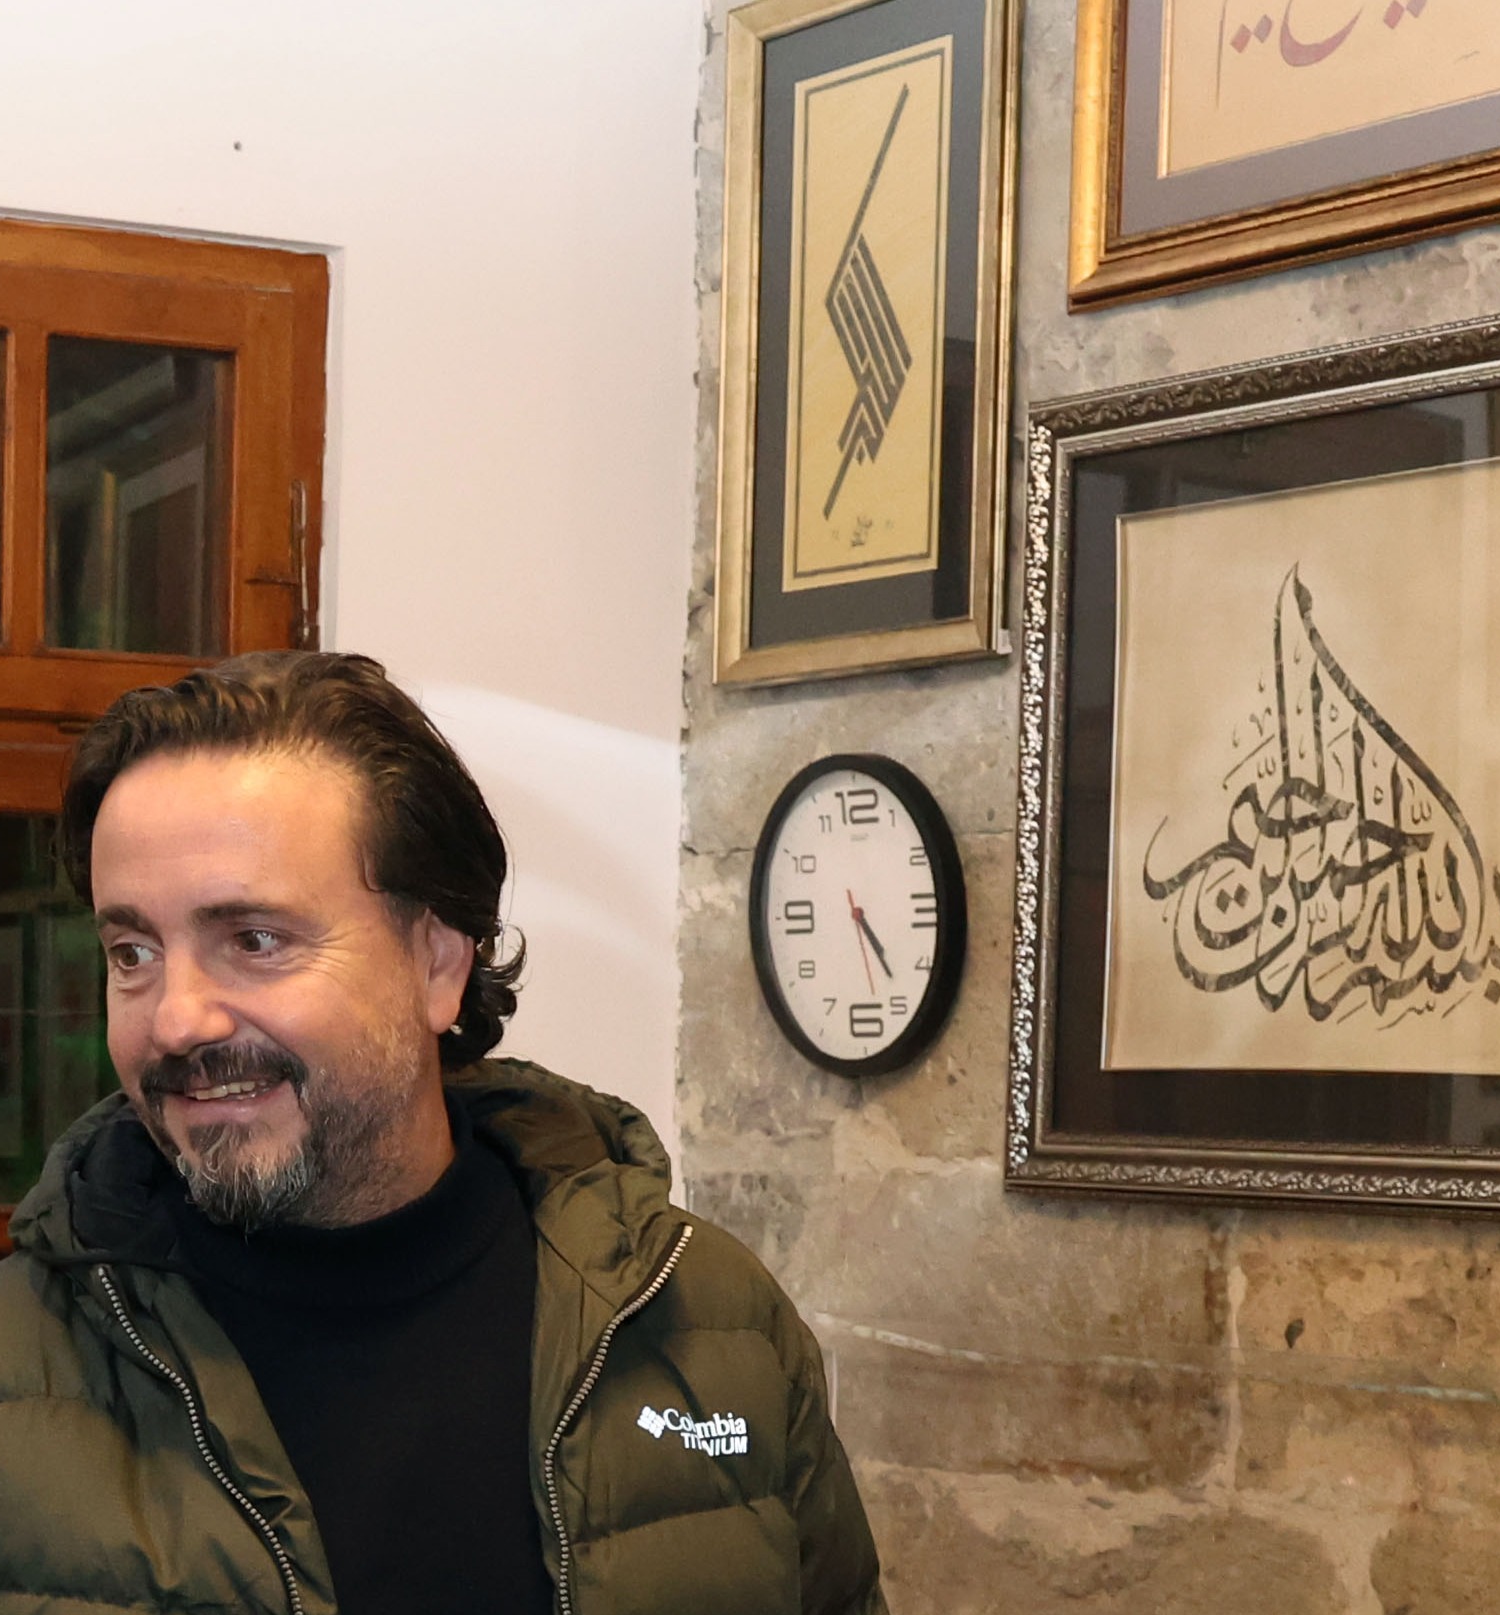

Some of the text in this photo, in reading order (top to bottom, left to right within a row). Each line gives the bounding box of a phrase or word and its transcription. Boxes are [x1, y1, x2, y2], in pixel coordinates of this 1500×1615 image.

[835, 789, 880, 825] 12
[819, 815, 832, 833] 11
[889, 809, 896, 828] 1
[792, 855, 816, 874] 10
[910, 847, 928, 866] 2
[784, 900, 815, 934] 9
[799, 960, 816, 979] 8
[915, 955, 931, 972] 4
[823, 997, 837, 1015] 7
[889, 996, 909, 1015] 5
[849, 1003, 884, 1038] 6
[663, 1408, 747, 1439] Colmbia
